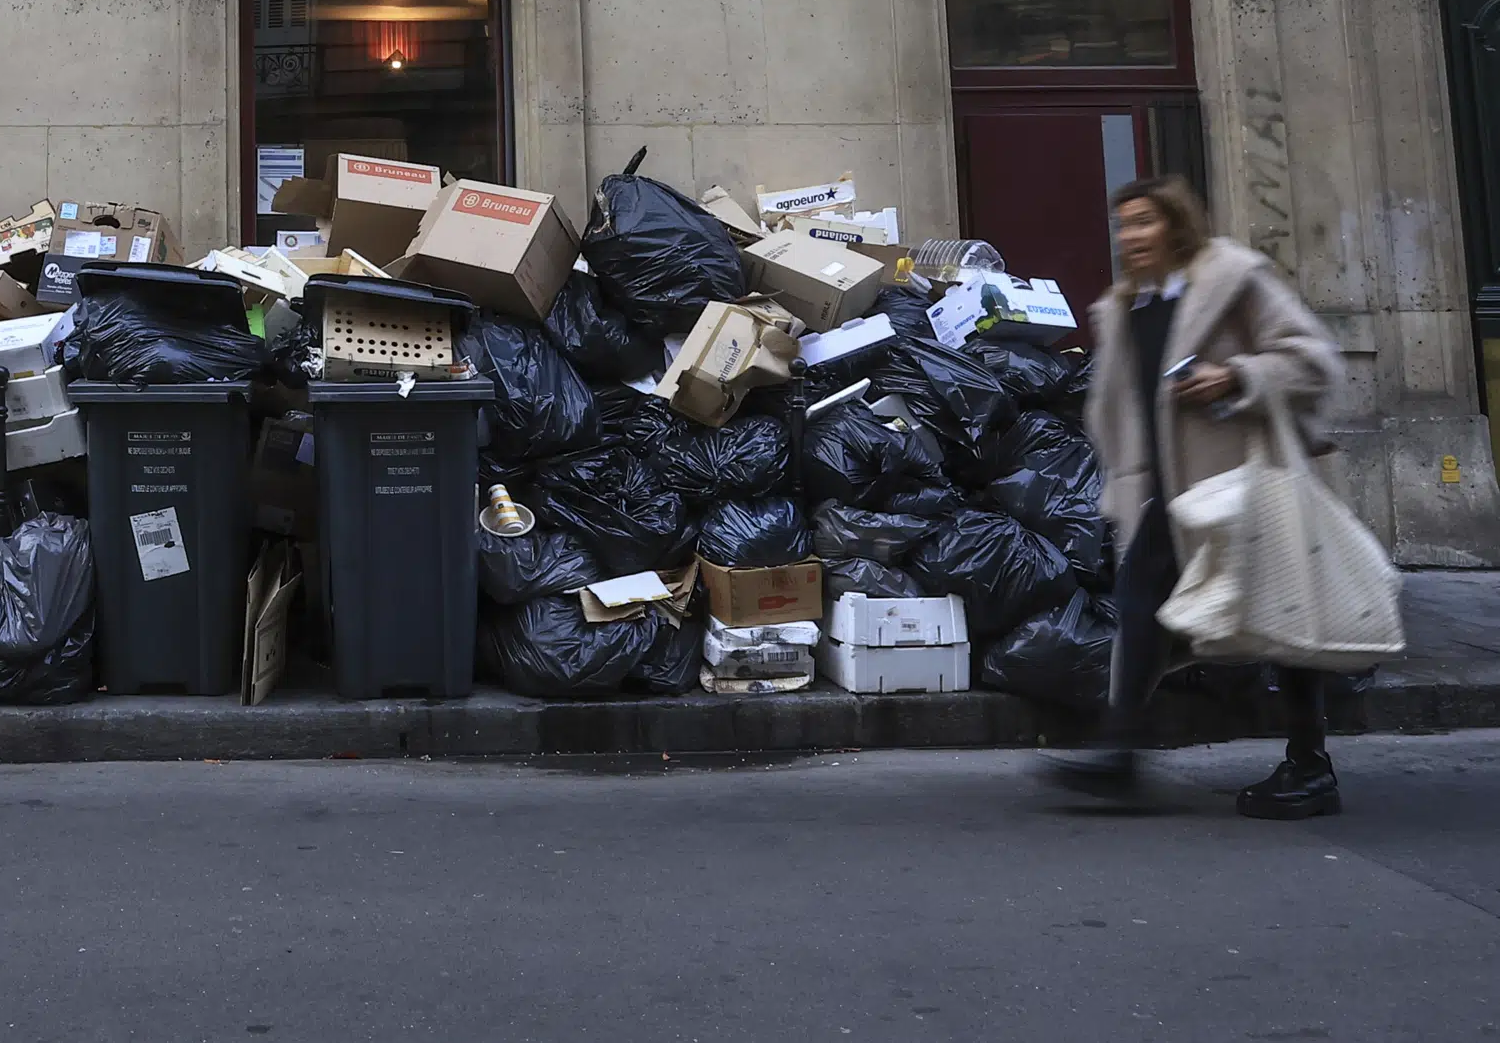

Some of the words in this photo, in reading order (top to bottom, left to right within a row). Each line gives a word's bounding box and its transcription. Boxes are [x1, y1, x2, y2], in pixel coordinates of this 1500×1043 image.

[374, 166, 426, 179] Bruneau
[481, 199, 532, 217] Bruneau
[776, 193, 825, 210] agroeuro
[815, 230, 857, 242] Holland
